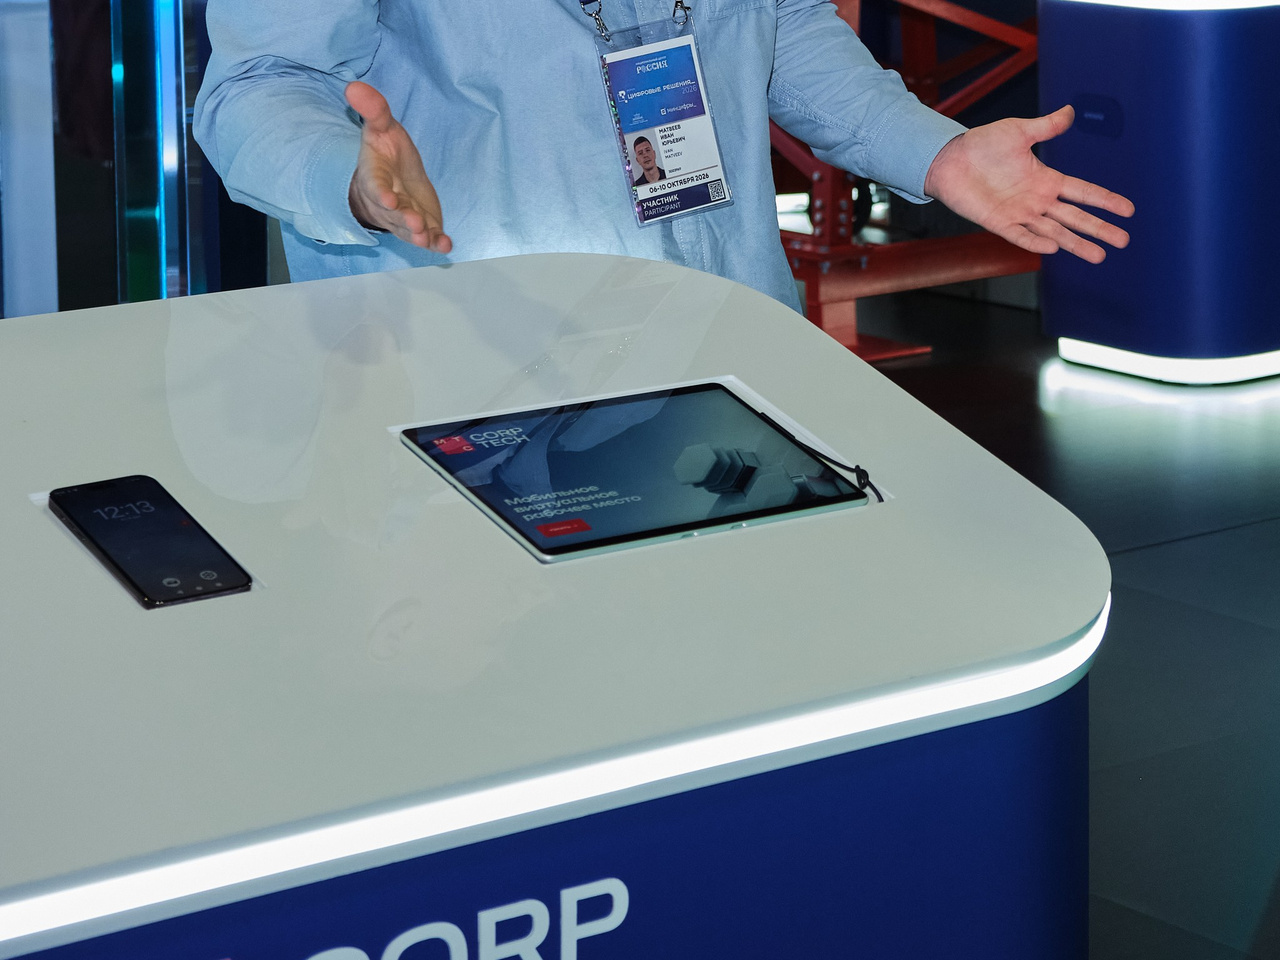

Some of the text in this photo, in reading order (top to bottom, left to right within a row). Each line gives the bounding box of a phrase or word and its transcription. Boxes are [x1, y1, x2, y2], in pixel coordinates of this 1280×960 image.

[636, 60, 668, 74] РОССИЯ
[628, 86, 662, 100] ЦИФРОВЫЕ
[682, 86, 697, 94] 2026
[659, 124, 681, 134] МАТВЕЕВ
[649, 172, 710, 194] 06-10 ОКТЯБРЯ 2026
[642, 194, 679, 209] УЧАСТНИК
[644, 202, 681, 217] PARTICIPANT
[469, 426, 524, 442] CORP
[475, 434, 530, 448] TECH
[504, 484, 600, 507] Мобильное
[513, 489, 619, 516] виртуальное
[93, 500, 155, 520] 12:13
[522, 496, 642, 524] рабочее место
[304, 877, 630, 960] RP
